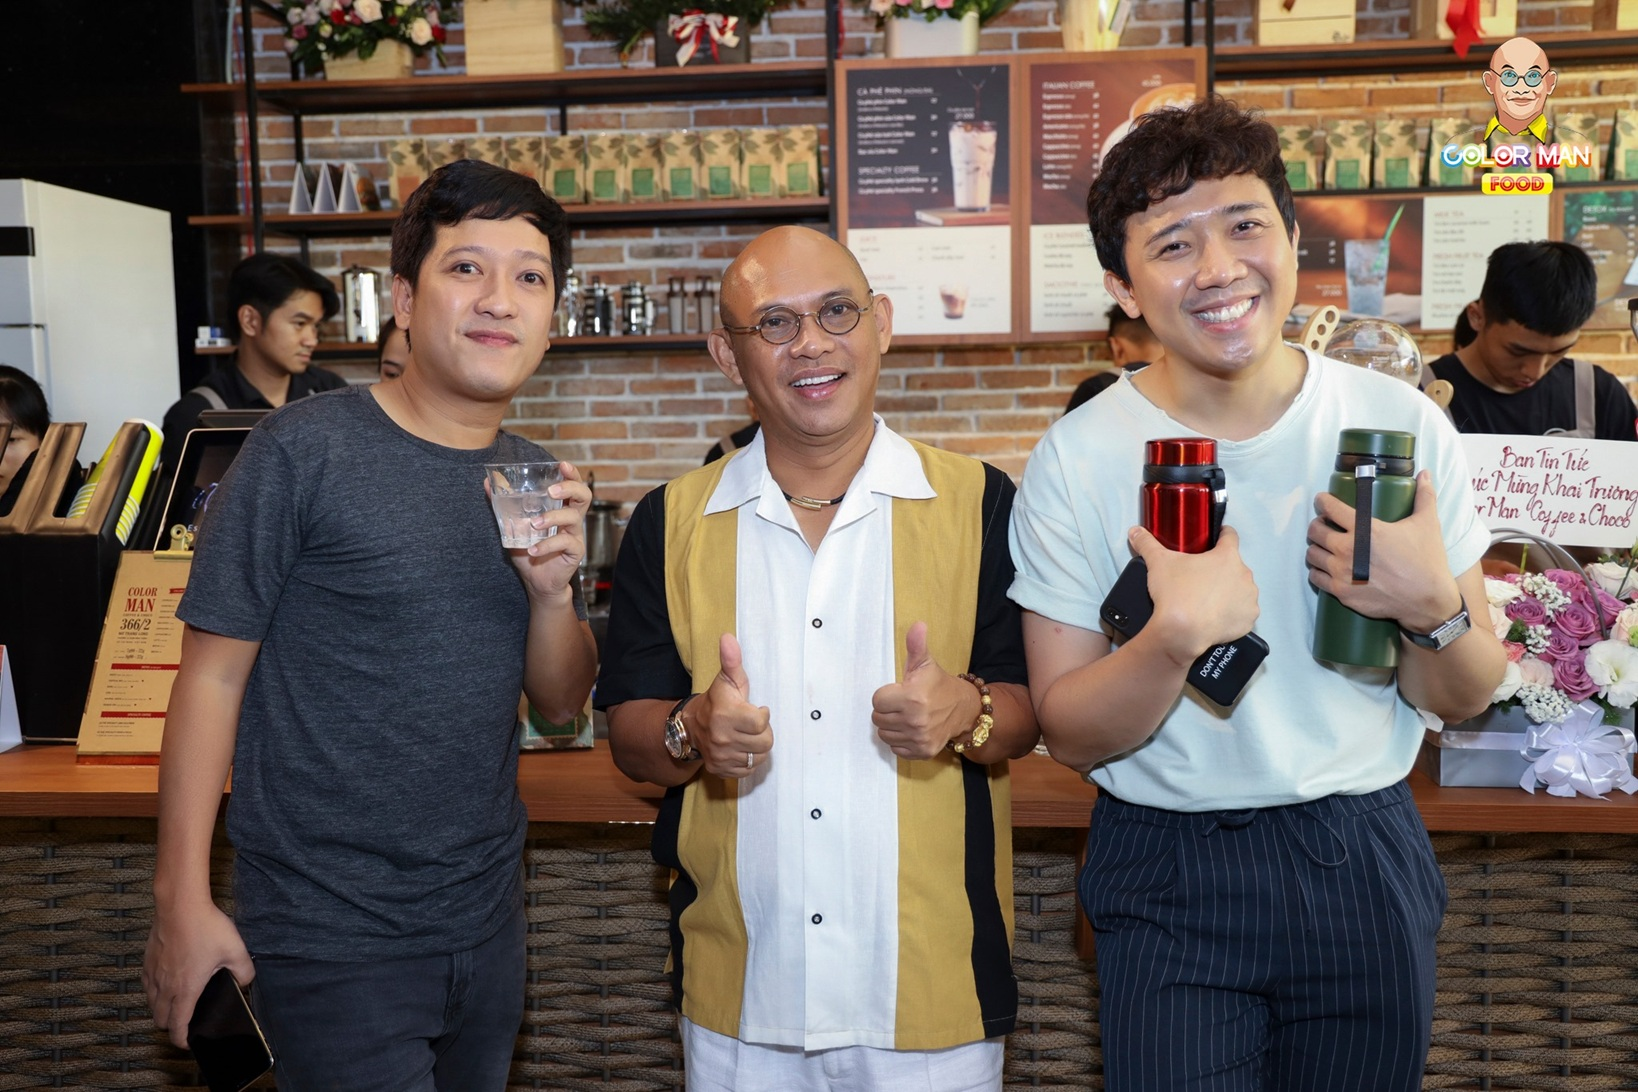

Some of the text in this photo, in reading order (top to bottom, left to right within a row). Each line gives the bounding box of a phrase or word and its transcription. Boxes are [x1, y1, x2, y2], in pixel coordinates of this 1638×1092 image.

[1500, 446, 1535, 469] Ban
[1536, 447, 1560, 470] Tin
[1542, 473, 1583, 500] Khai
[1487, 496, 1520, 519] Man
[128, 587, 158, 598] COLOR
[124, 598, 156, 613] MAN
[120, 618, 152, 631] 366/2
[1211, 645, 1238, 680] MY PHONE
